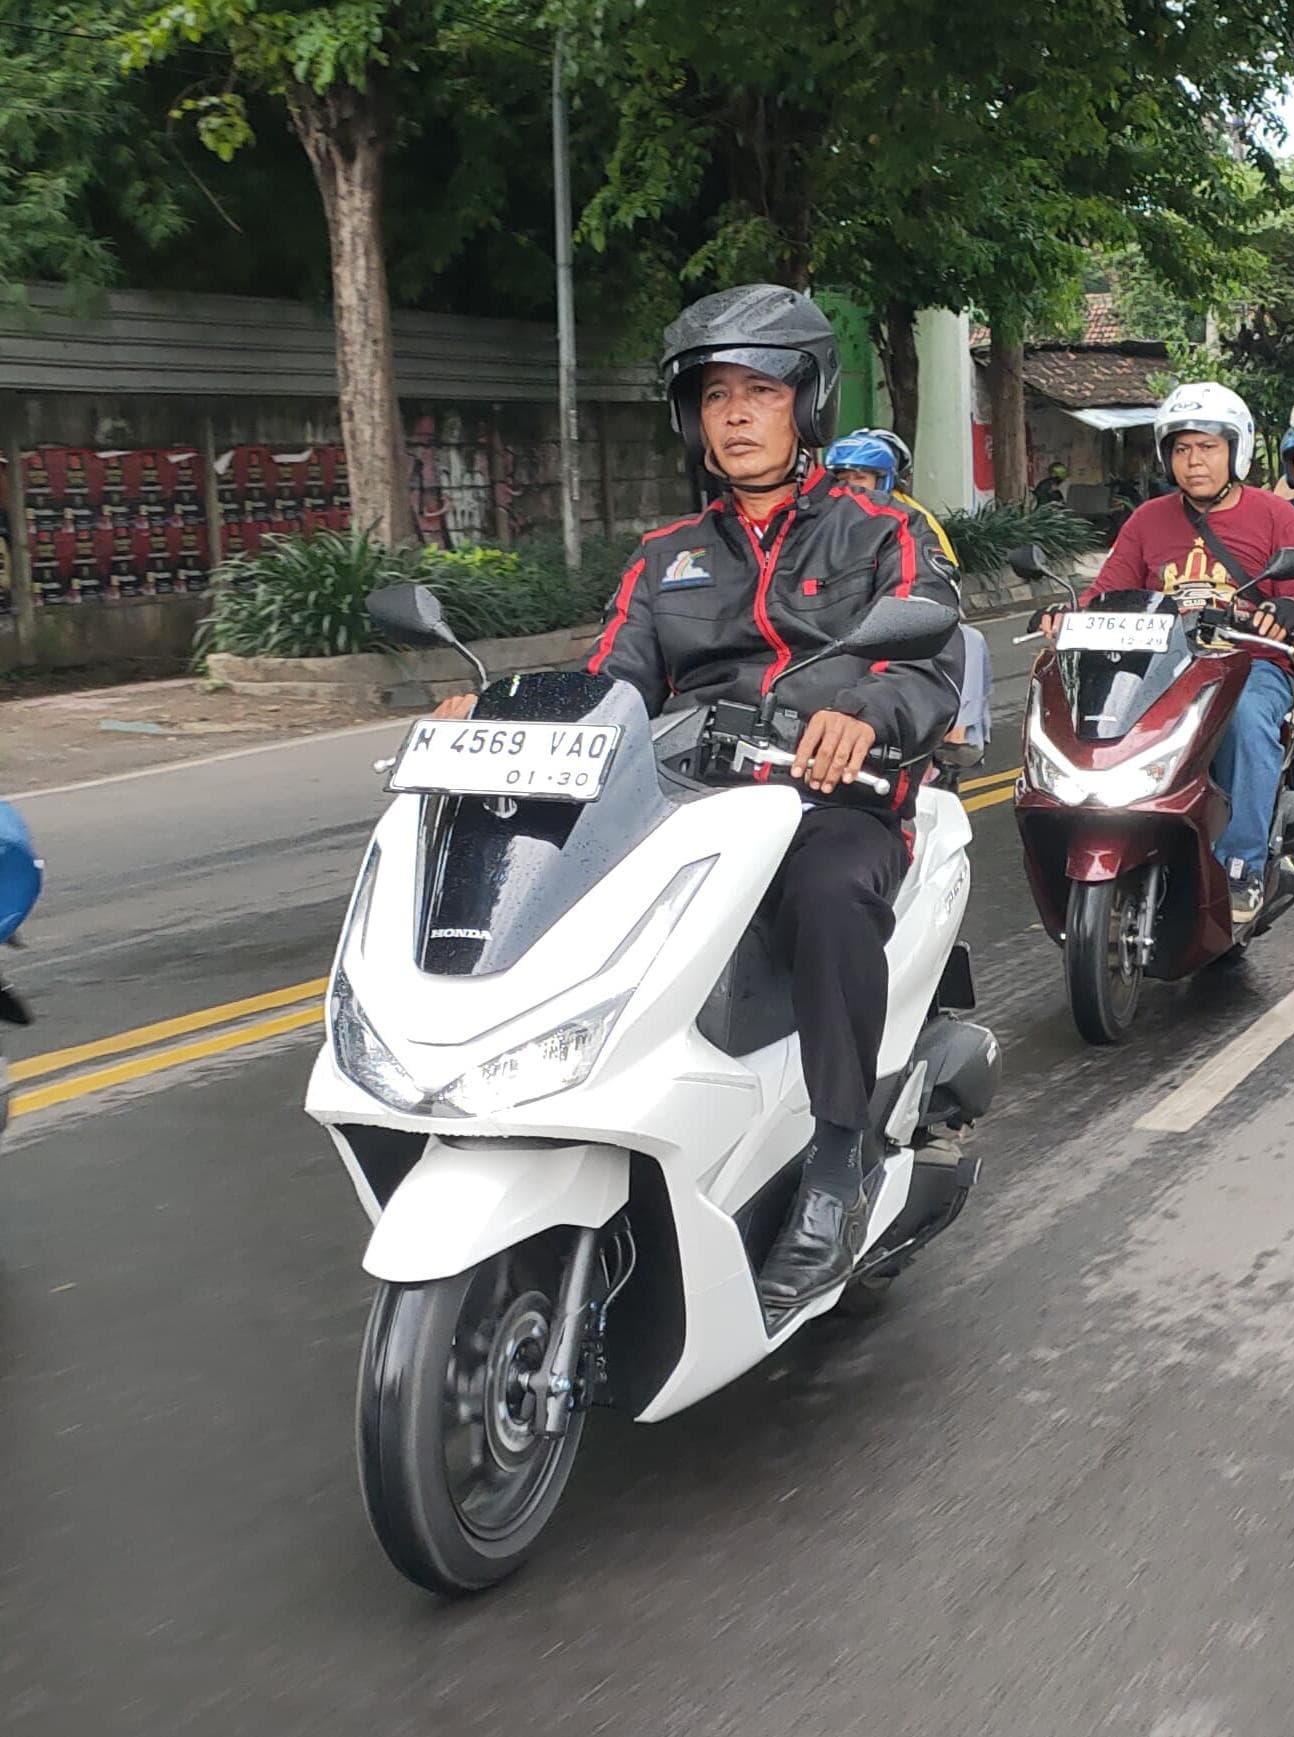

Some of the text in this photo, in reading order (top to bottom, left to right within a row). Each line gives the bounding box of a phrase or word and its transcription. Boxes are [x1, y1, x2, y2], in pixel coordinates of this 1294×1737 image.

[1065, 616, 1168, 631] L 3764 CAX
[412, 727, 437, 751] N
[450, 728, 527, 756] 4569
[430, 928, 493, 941] HONDA
